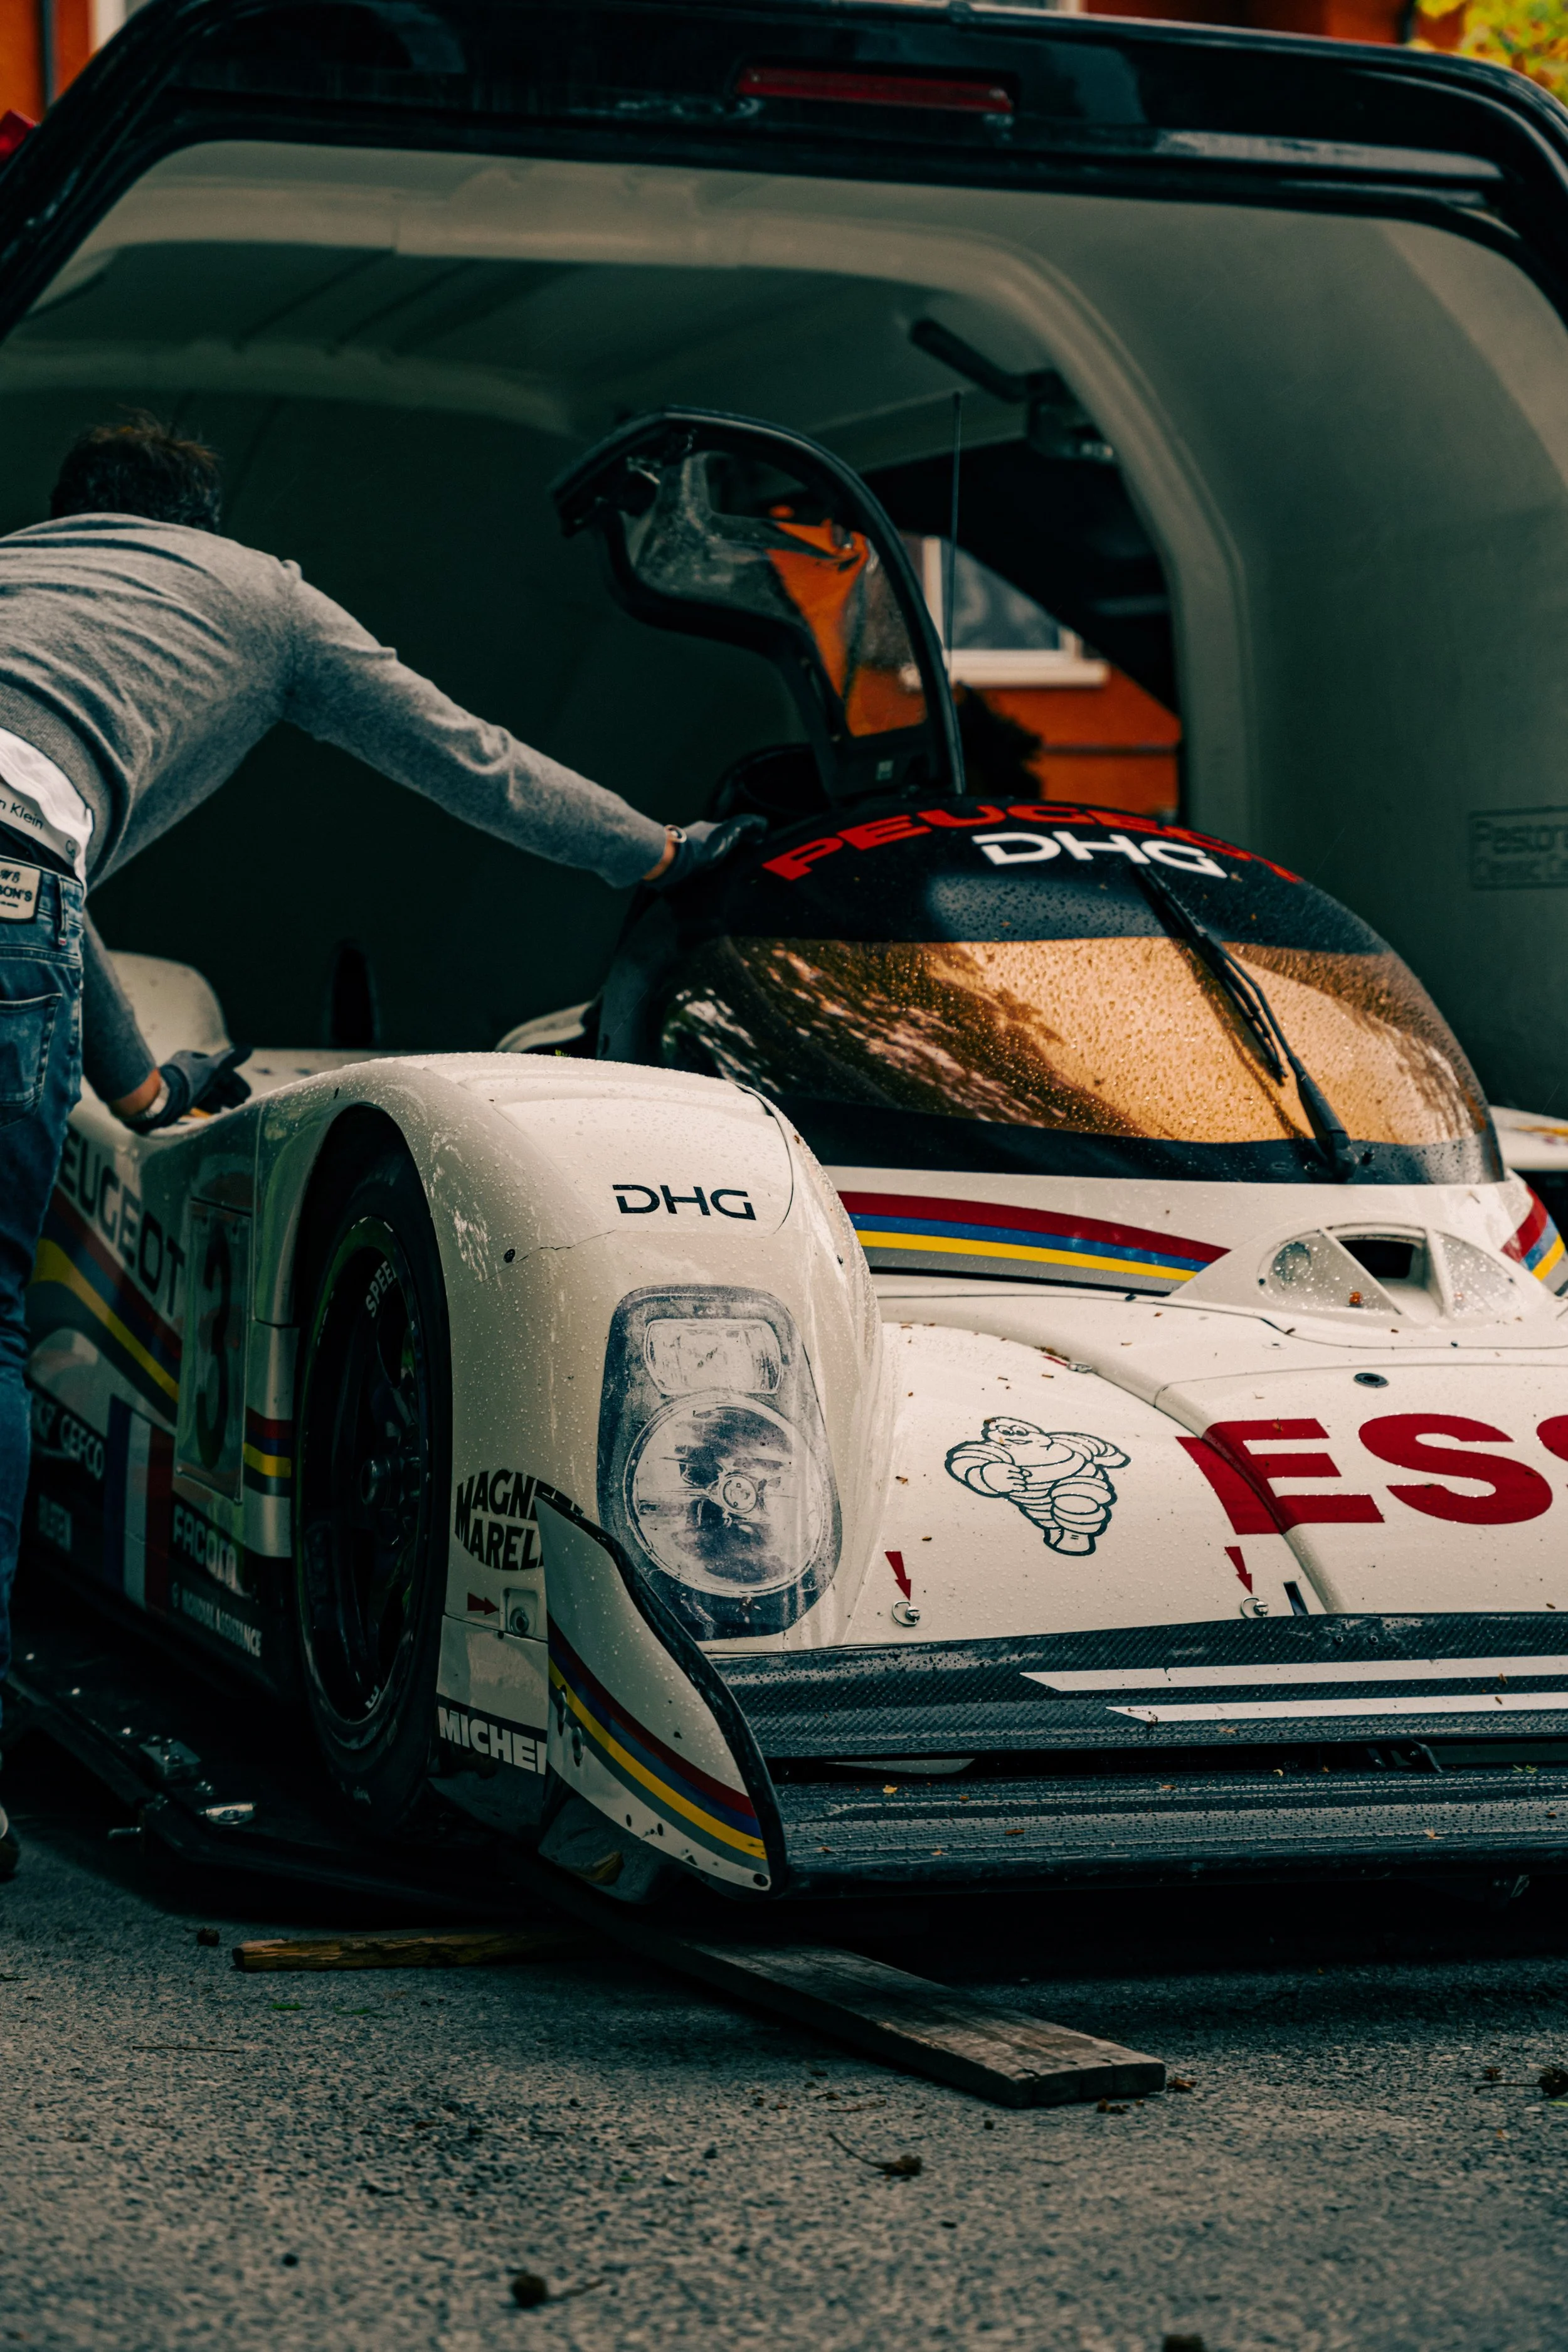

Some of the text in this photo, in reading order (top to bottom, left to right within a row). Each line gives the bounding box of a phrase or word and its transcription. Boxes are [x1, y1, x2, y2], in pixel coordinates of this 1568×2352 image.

[10, 803, 43, 830] Klein
[971, 831, 1228, 879] DHG
[613, 1185, 756, 1220] DHG
[196, 1223, 231, 1470] 3
[1175, 1413, 1568, 1535] ES
[455, 1510, 544, 1571] MAREL
